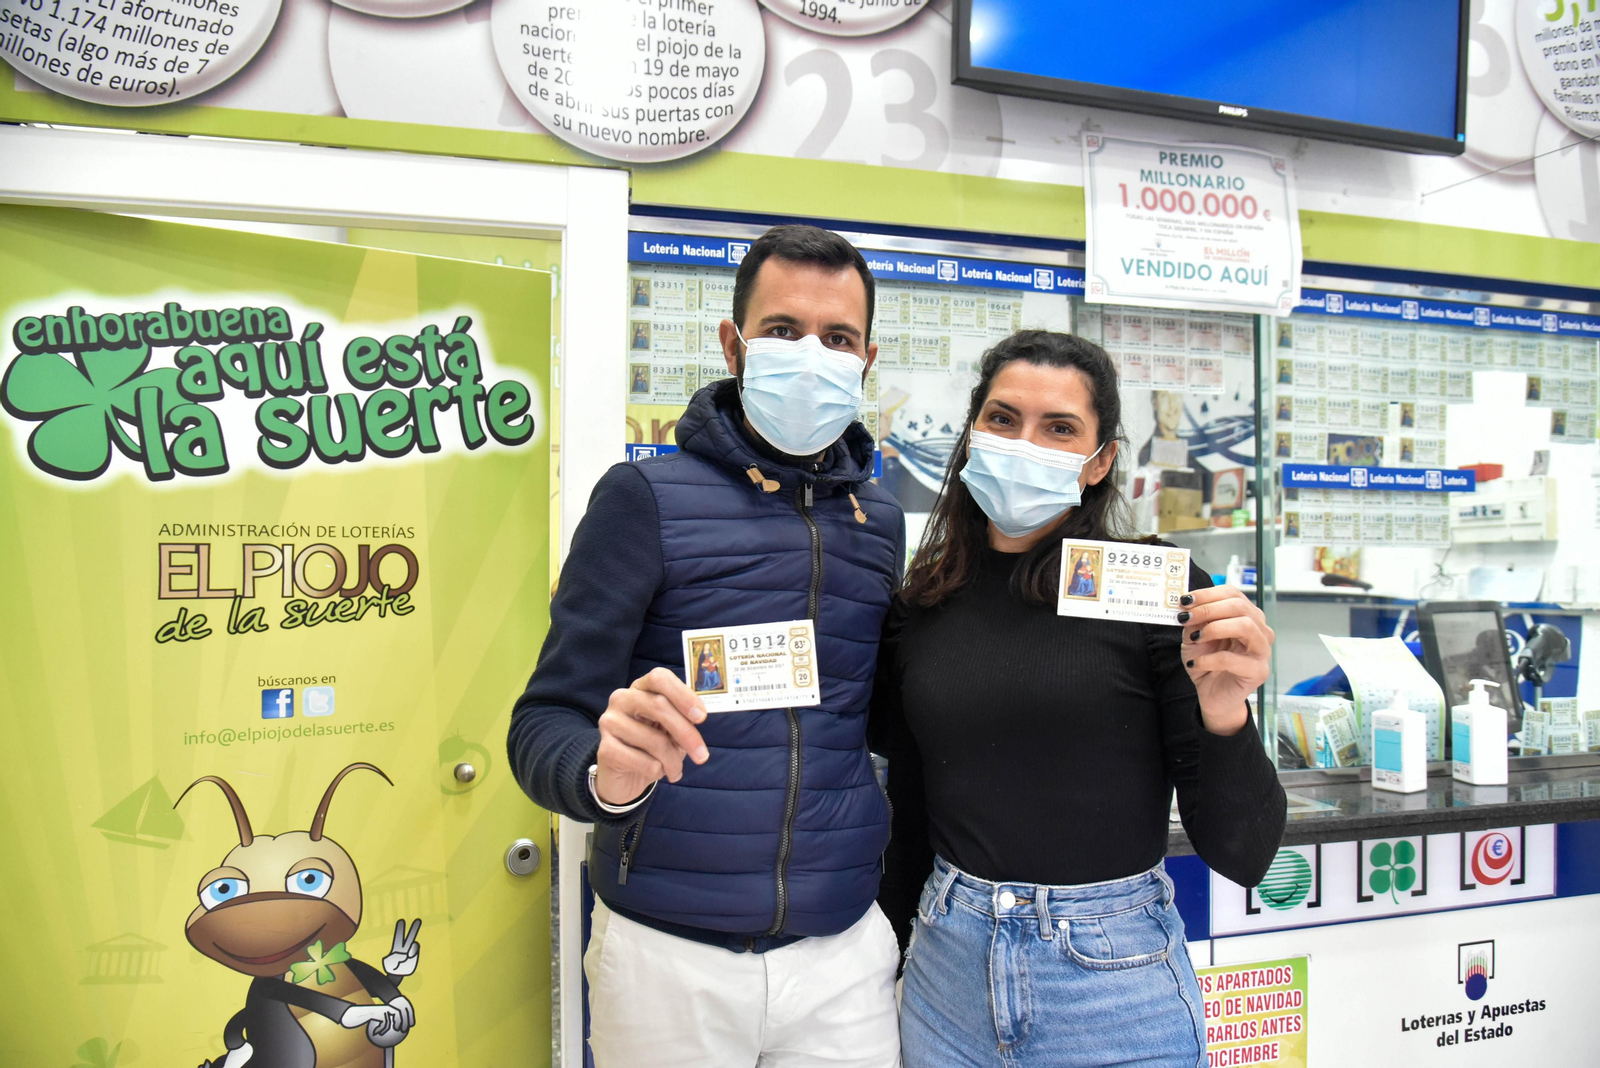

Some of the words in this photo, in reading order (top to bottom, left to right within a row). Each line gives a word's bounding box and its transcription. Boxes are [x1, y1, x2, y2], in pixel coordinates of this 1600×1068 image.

[121, 0, 234, 36] afortunado
[799, 0, 842, 24] 1994.
[48, 0, 108, 34] 1.174
[112, 23, 199, 53] millones
[204, 38, 230, 56] de
[643, 9, 657, 30] la
[662, 12, 716, 38] lotería
[1579, 18, 1593, 34] da
[57, 28, 109, 62] (algo
[114, 50, 158, 71] más
[163, 55, 190, 75] de
[196, 58, 210, 75] 7
[636, 33, 651, 52] el
[656, 36, 699, 60] piojo
[703, 41, 724, 59] de
[728, 43, 742, 60] la
[1542, 39, 1578, 60] premio
[1579, 35, 1596, 53] del
[643, 57, 664, 77] 19
[669, 60, 690, 78] de
[695, 63, 740, 81] mayo
[1553, 58, 1580, 72] dono
[1581, 57, 1595, 70] en
[76, 63, 103, 86] de
[108, 75, 181, 98] euros).
[527, 61, 549, 81] de
[647, 84, 698, 103] pocos
[702, 82, 736, 99] días
[528, 81, 550, 101] de
[635, 105, 701, 126] puertas
[704, 102, 735, 119] con
[1553, 88, 1594, 105] familias
[553, 112, 573, 132] su
[578, 120, 633, 145] nuevo
[637, 126, 711, 147] nombre.
[1159, 151, 1224, 169] PREMIO
[1140, 169, 1245, 192] MILLONARIO
[1118, 183, 1258, 220] 1.000.000
[1263, 208, 1272, 222] €
[643, 241, 680, 256] Lotería
[682, 244, 725, 259] Nacional
[1203, 246, 1215, 256] EL
[1216, 247, 1251, 258] MILLÓN
[866, 260, 894, 272] otería
[896, 262, 935, 275] Nacional
[962, 267, 993, 280] Lotería
[995, 271, 1032, 284] Nacional
[1120, 257, 1212, 281] VENDIDO
[1219, 264, 1269, 286] AQUÍ
[653, 281, 684, 290] 83311
[912, 296, 940, 306] 99983
[1345, 299, 1371, 312] Lotería
[1371, 302, 1402, 315] Nacional
[1420, 306, 1445, 318] Lotería
[1445, 308, 1474, 321] Nacional
[1491, 313, 1515, 325] Lotería
[1515, 315, 1542, 327] Nacional
[12, 301, 292, 354] enhorabuena
[653, 323, 684, 332] 83311
[1558, 319, 1581, 330] Lotería
[911, 337, 939, 346] 99983
[175, 322, 328, 402] aquí
[342, 316, 484, 390] está
[652, 366, 684, 375] 83311
[702, 367, 731, 376] 0048
[134, 386, 230, 482] la
[254, 380, 536, 470] suerte
[1291, 470, 1318, 481] Lotería
[1319, 471, 1350, 483] Nacional
[1370, 473, 1394, 484] Lotería
[1395, 474, 1425, 485] Nacional
[1443, 475, 1468, 486] Lotería
[158, 522, 311, 538] ADMINISTRACIÓN
[316, 525, 336, 538] DE
[341, 524, 416, 539] LOTERÍAS
[1108, 552, 1163, 567] 92689
[158, 543, 237, 600] EL
[242, 543, 420, 600] PIOJO
[1169, 595, 1179, 603] 20
[155, 607, 213, 644] de
[227, 595, 269, 635] la
[280, 584, 415, 629] suerte
[729, 634, 786, 651] 01912
[729, 653, 755, 661] LOTERÍA
[756, 651, 788, 659] NACIONAL
[749, 658, 778, 666] NAVIDAD
[257, 675, 318, 688] búscanos
[320, 675, 337, 685] en
[798, 673, 808, 681] 20
[183, 719, 396, 748] info@elpiojodelasuerte.es
[1216, 966, 1292, 992] APARTADOS
[1204, 1000, 1221, 1019] EO
[1225, 997, 1242, 1016] DE
[1246, 990, 1303, 1014] NAVIDAD
[1467, 1009, 1477, 1026] y
[1480, 998, 1547, 1022] Apuestas
[1261, 1015, 1302, 1037] ANTES
[1436, 1029, 1459, 1048] del
[1463, 1022, 1513, 1043] Estado
